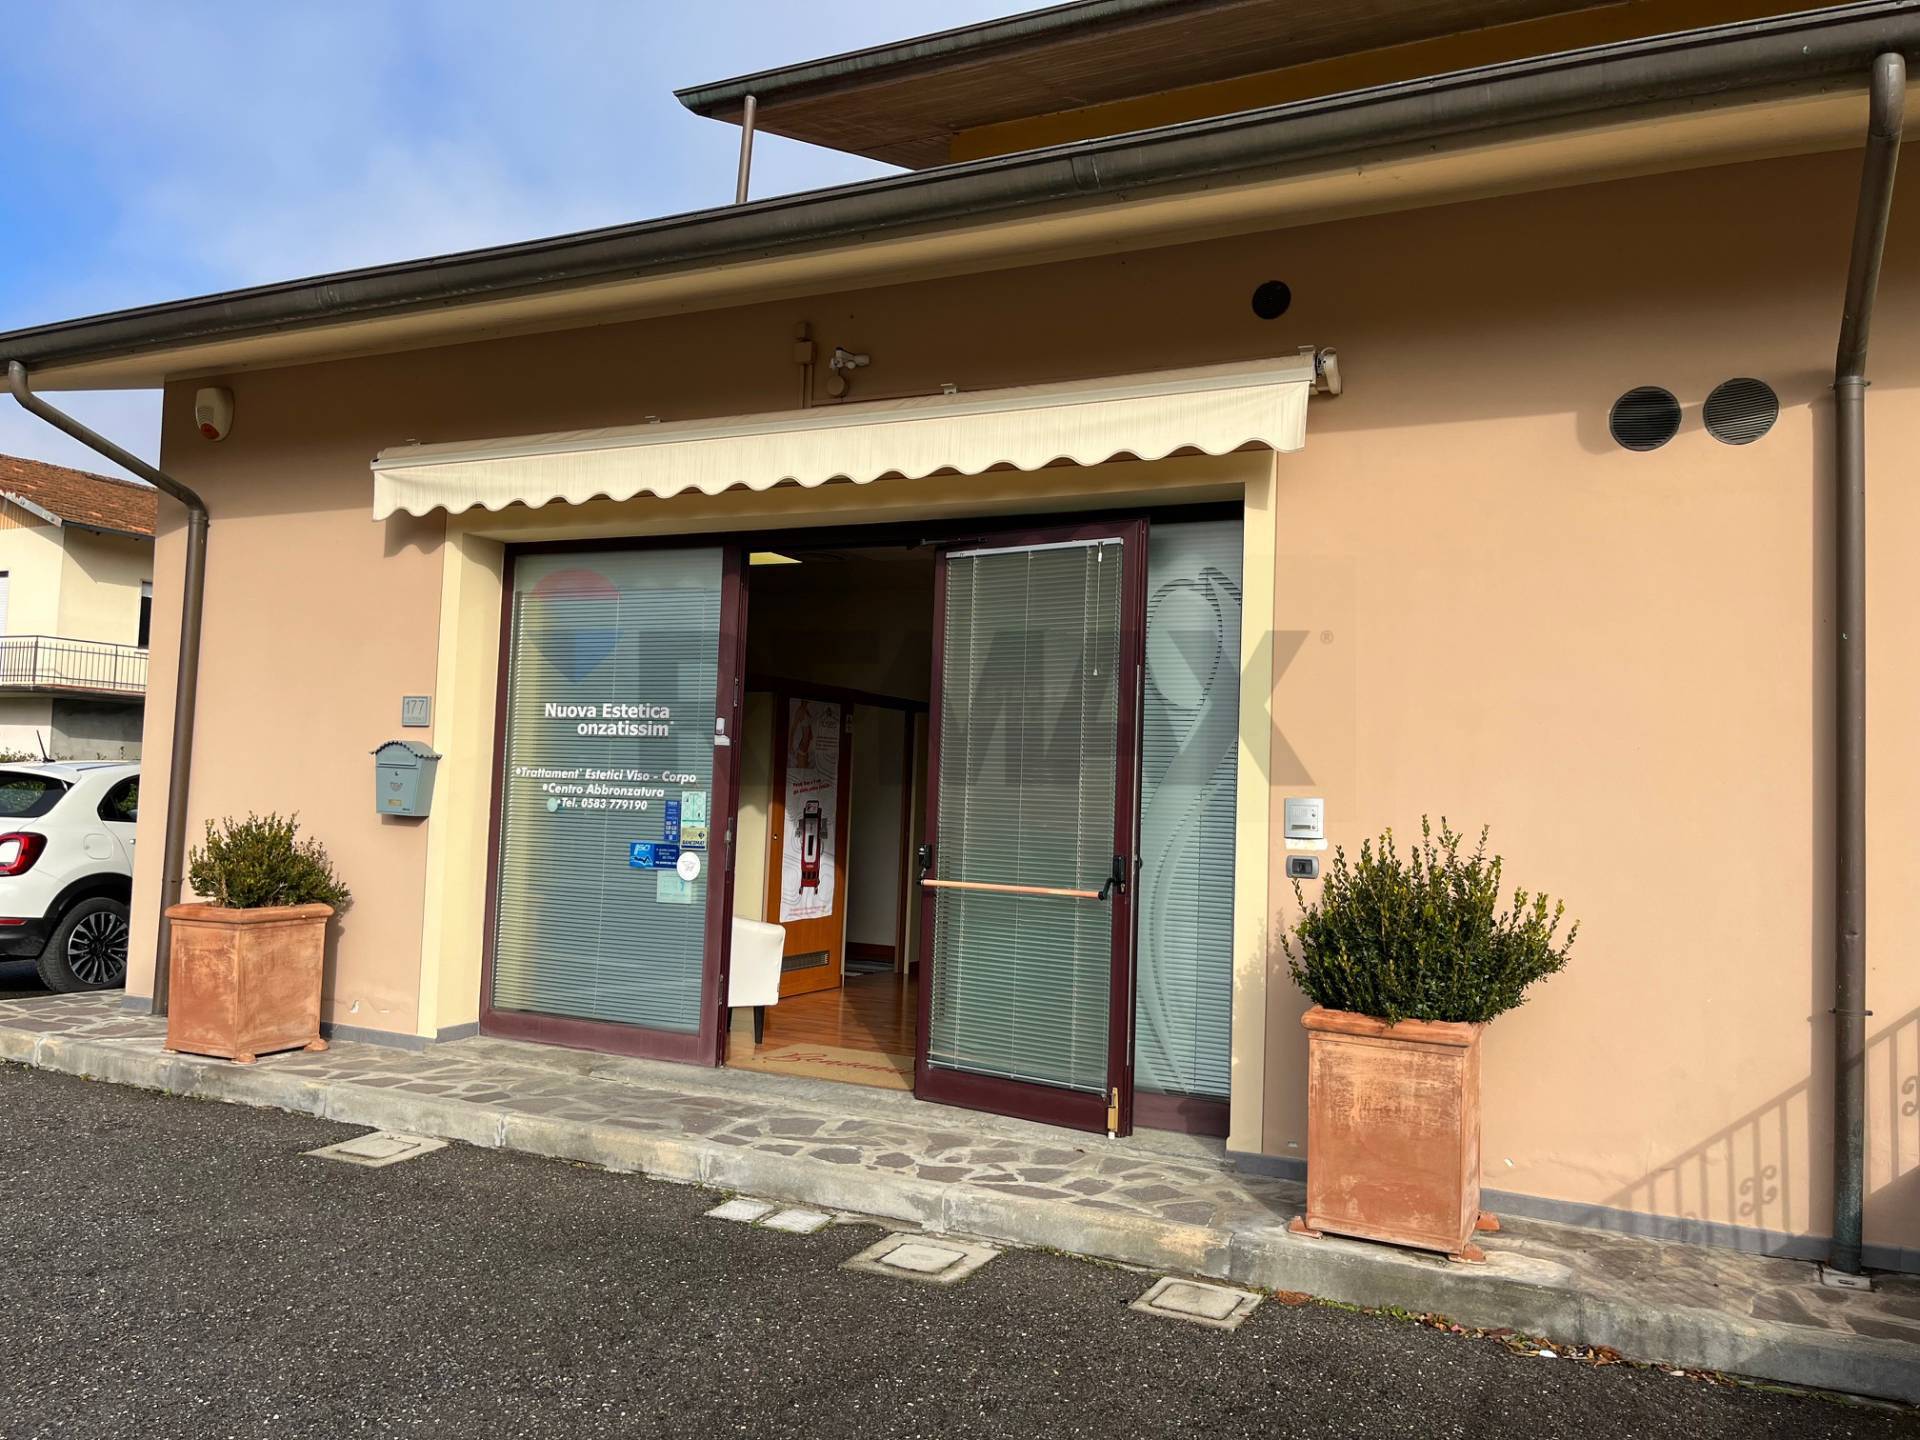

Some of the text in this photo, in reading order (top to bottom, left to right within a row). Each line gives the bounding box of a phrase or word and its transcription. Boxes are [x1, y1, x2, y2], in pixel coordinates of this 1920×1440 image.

[406, 699, 425, 714] 177
[544, 703, 670, 719] Nuova Estetica
[577, 721, 674, 737] onzatissim
[521, 767, 583, 779] Trattament
[585, 768, 624, 780] Estetici
[626, 770, 650, 781] Viso
[662, 771, 697, 785] Corpo
[547, 783, 665, 798] Centro Abbronzatura
[561, 798, 648, 811] Tel. 0583 779190
